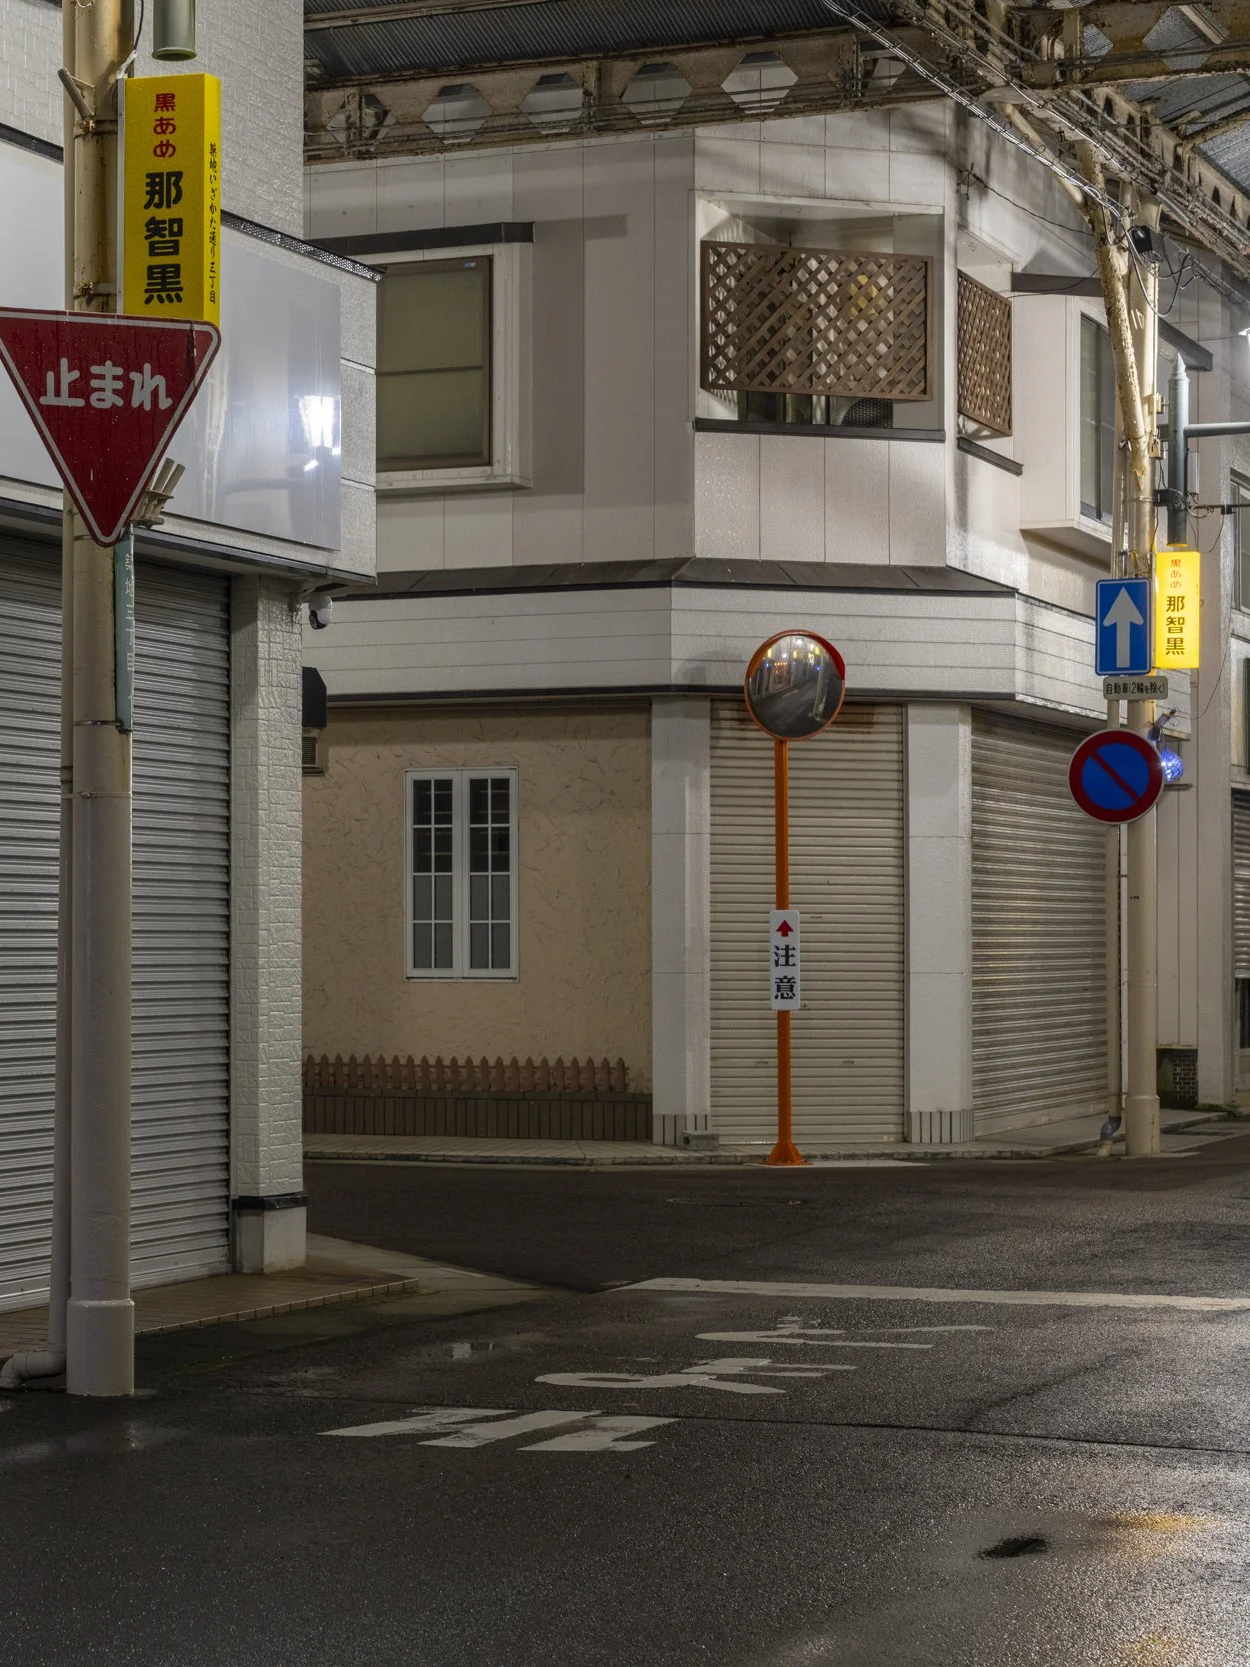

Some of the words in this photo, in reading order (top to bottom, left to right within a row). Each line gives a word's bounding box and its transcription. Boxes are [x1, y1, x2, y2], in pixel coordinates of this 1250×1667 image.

[153, 92, 177, 158] 黒あめ
[143, 170, 184, 305] 那智黒
[39, 357, 173, 411] 止まれ
[1171, 559, 1181, 588] 黒あめ
[1166, 596, 1185, 655] 那智黒
[773, 944, 797, 1000] 注意
